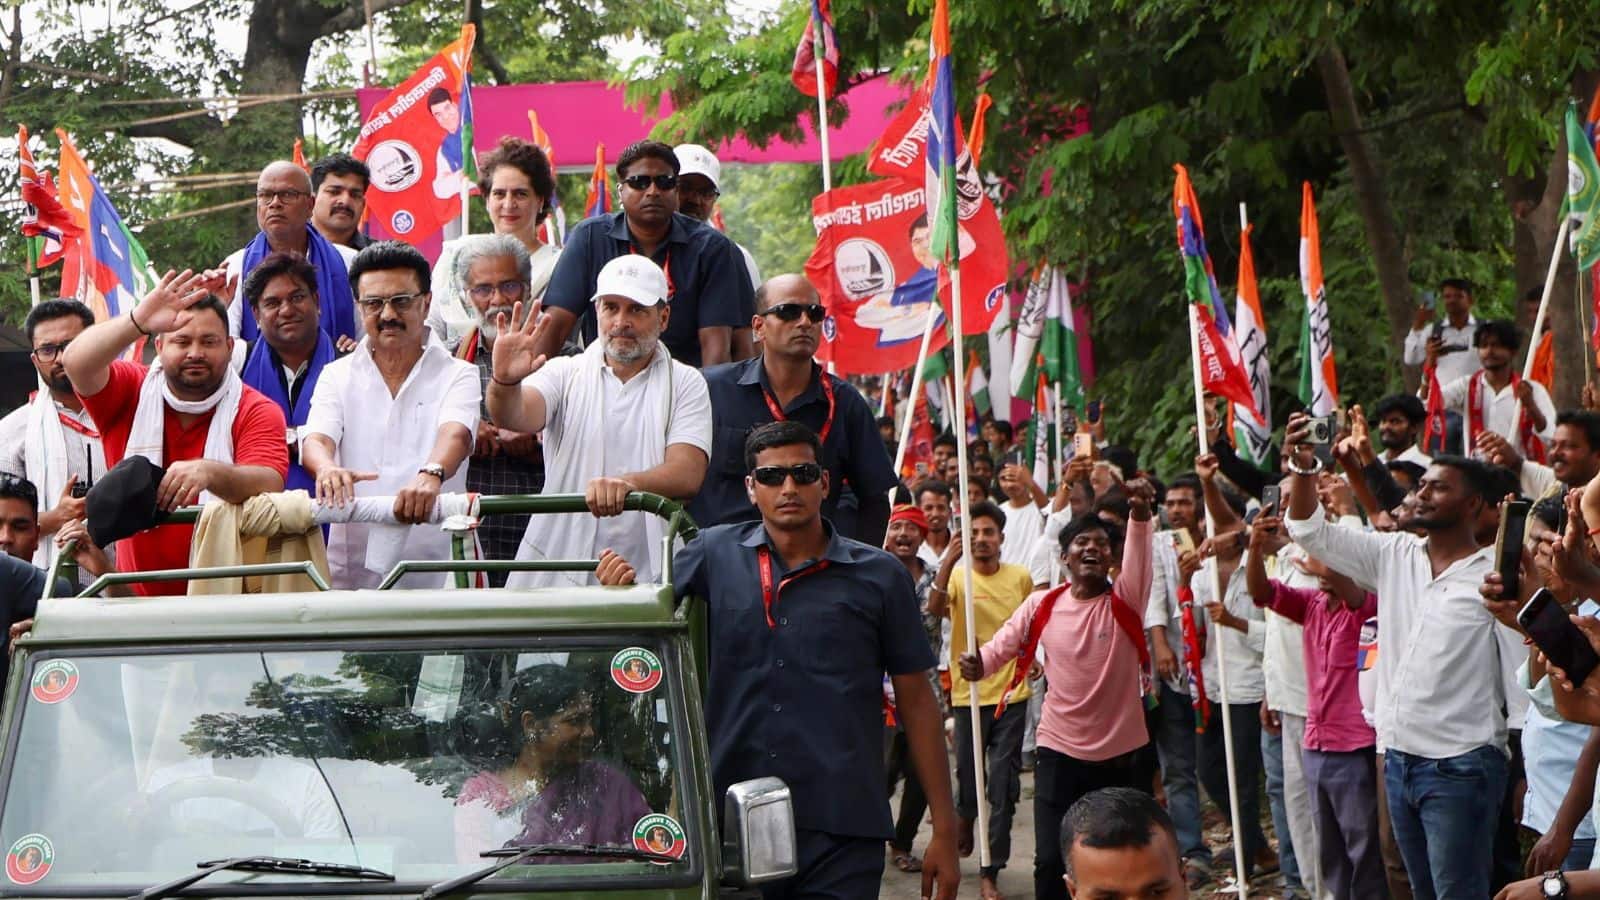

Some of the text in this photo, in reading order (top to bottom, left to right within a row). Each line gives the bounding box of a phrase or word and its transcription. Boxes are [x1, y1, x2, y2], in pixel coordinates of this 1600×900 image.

[615, 650, 657, 666] CONSERVE TIGER
[637, 817, 680, 834] CONSERVE TIGER
